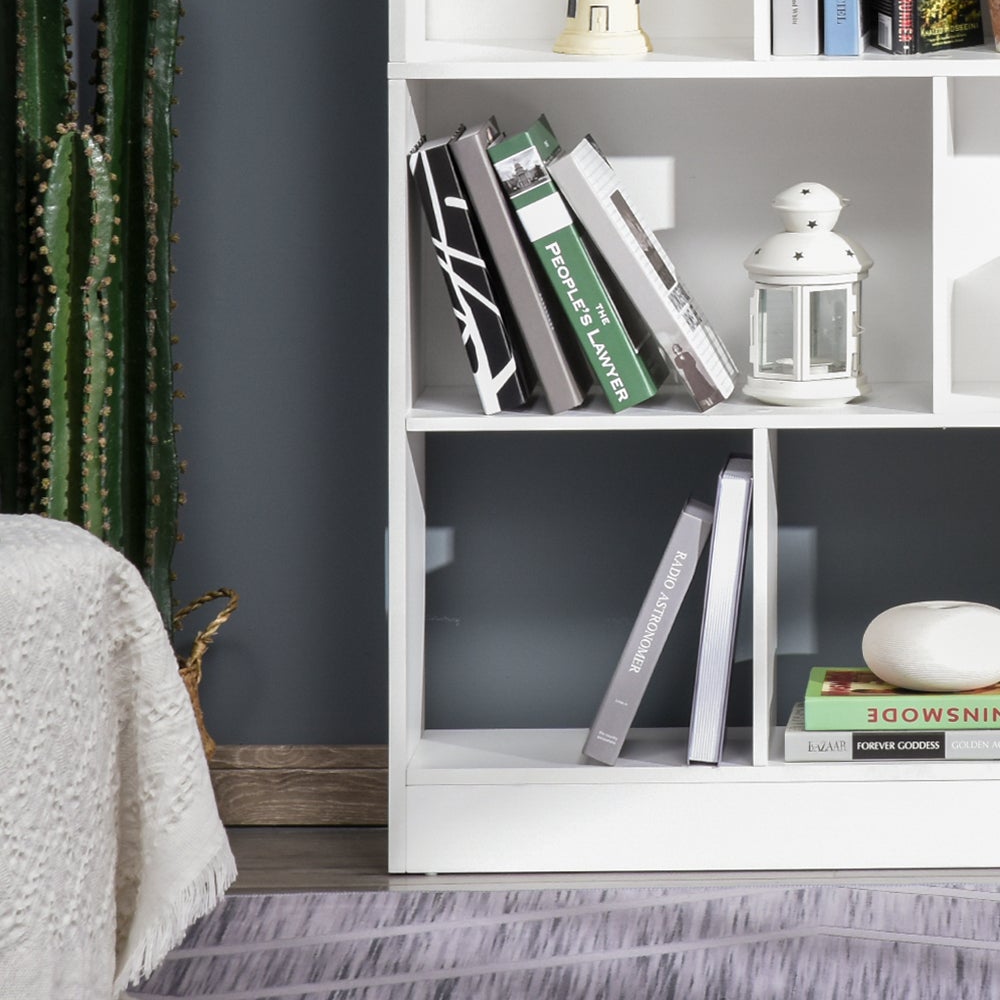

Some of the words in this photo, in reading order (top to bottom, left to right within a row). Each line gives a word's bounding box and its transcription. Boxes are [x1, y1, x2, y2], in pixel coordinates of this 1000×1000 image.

[545, 241, 592, 327] PEOPLE'S
[587, 328, 629, 402] LAWYER
[595, 303, 610, 325] THE
[663, 550, 688, 589] RADIO
[629, 591, 669, 673] ASTRONOMER
[857, 740, 895, 751] FOREVER
[898, 740, 940, 751] GODDESS
[951, 740, 989, 750] GOLDEN
